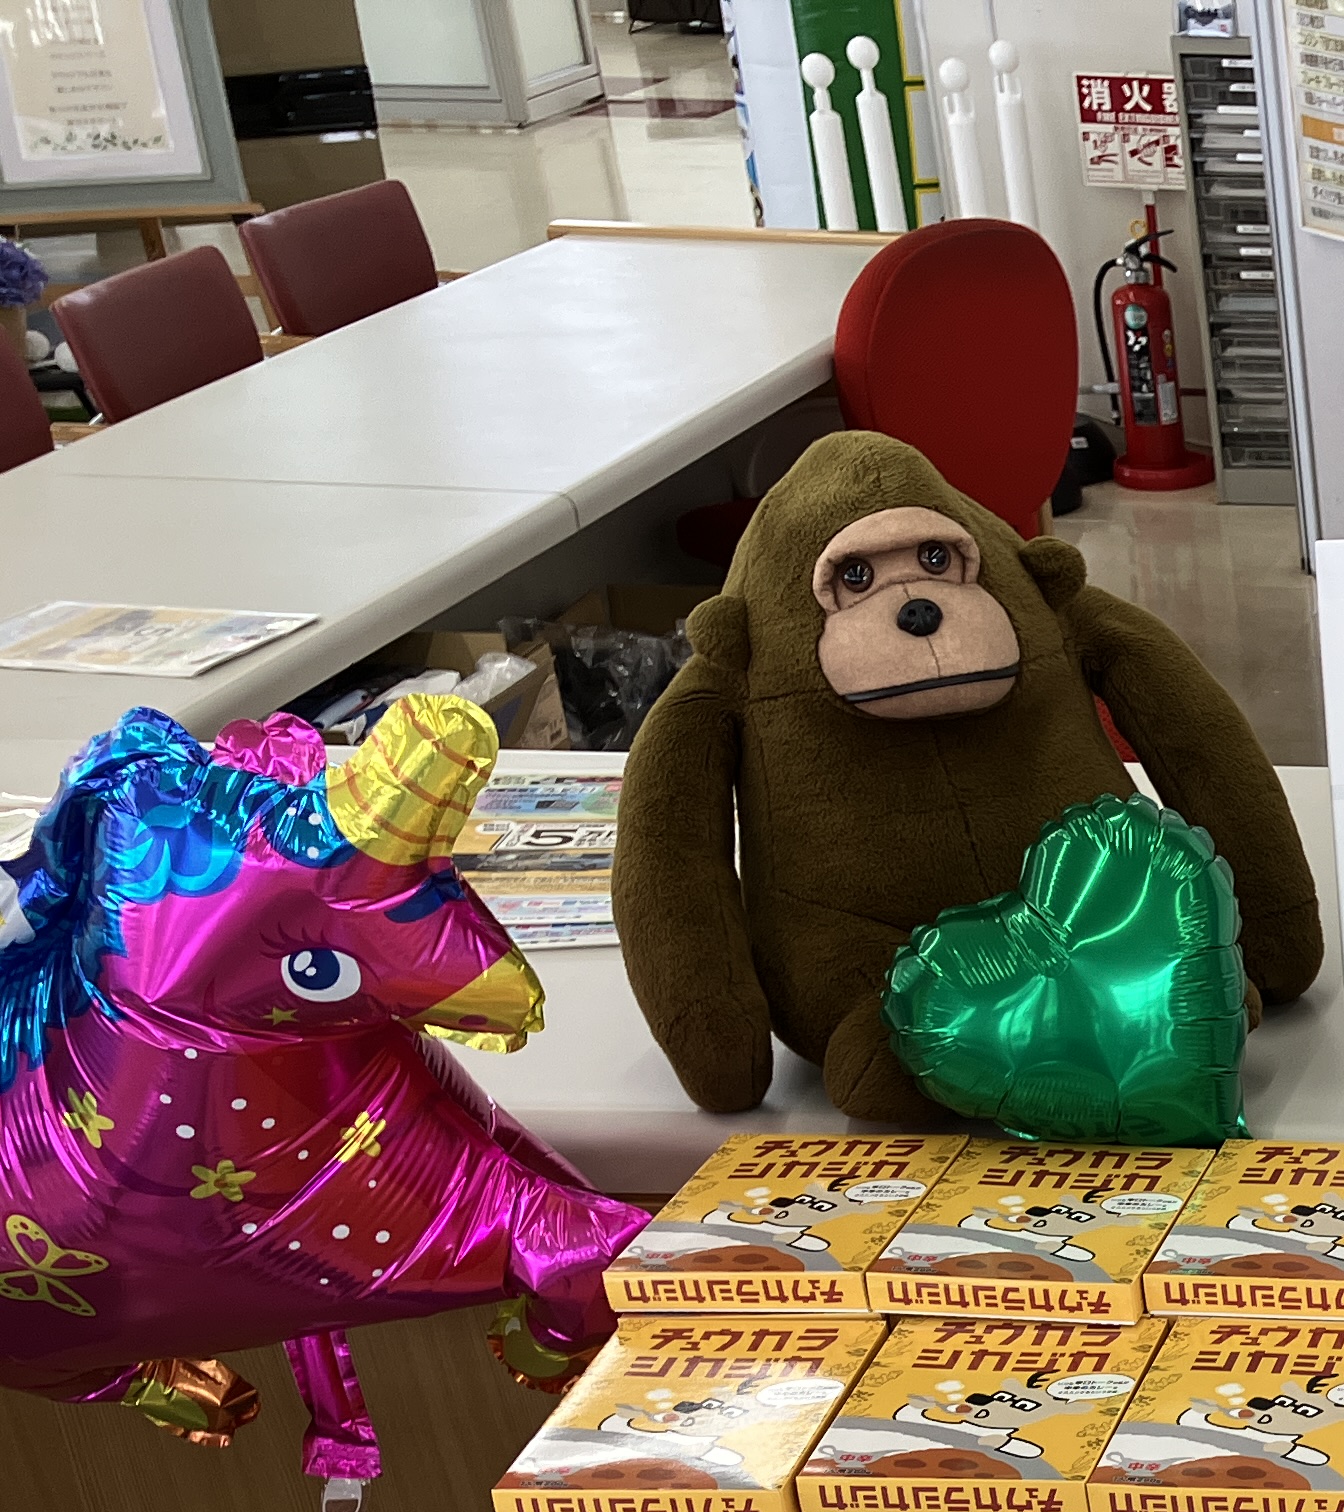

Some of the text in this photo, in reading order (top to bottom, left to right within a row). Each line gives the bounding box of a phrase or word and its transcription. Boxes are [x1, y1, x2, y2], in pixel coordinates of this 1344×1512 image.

[753, 1139, 926, 1159] チュウカラ
[999, 1146, 1174, 1167] チュウカラ
[728, 1160, 914, 1180] シカジカ
[978, 1168, 1165, 1190] シカジカ
[624, 1280, 843, 1303] チュウカラシカジカ
[650, 1328, 839, 1352] チュウカラ
[933, 1322, 1123, 1346] チュウカラ
[628, 1355, 825, 1378] シカジカ
[911, 1348, 1110, 1373] シカジカ
[819, 1486, 1062, 1512] チュウカラシカジカ
